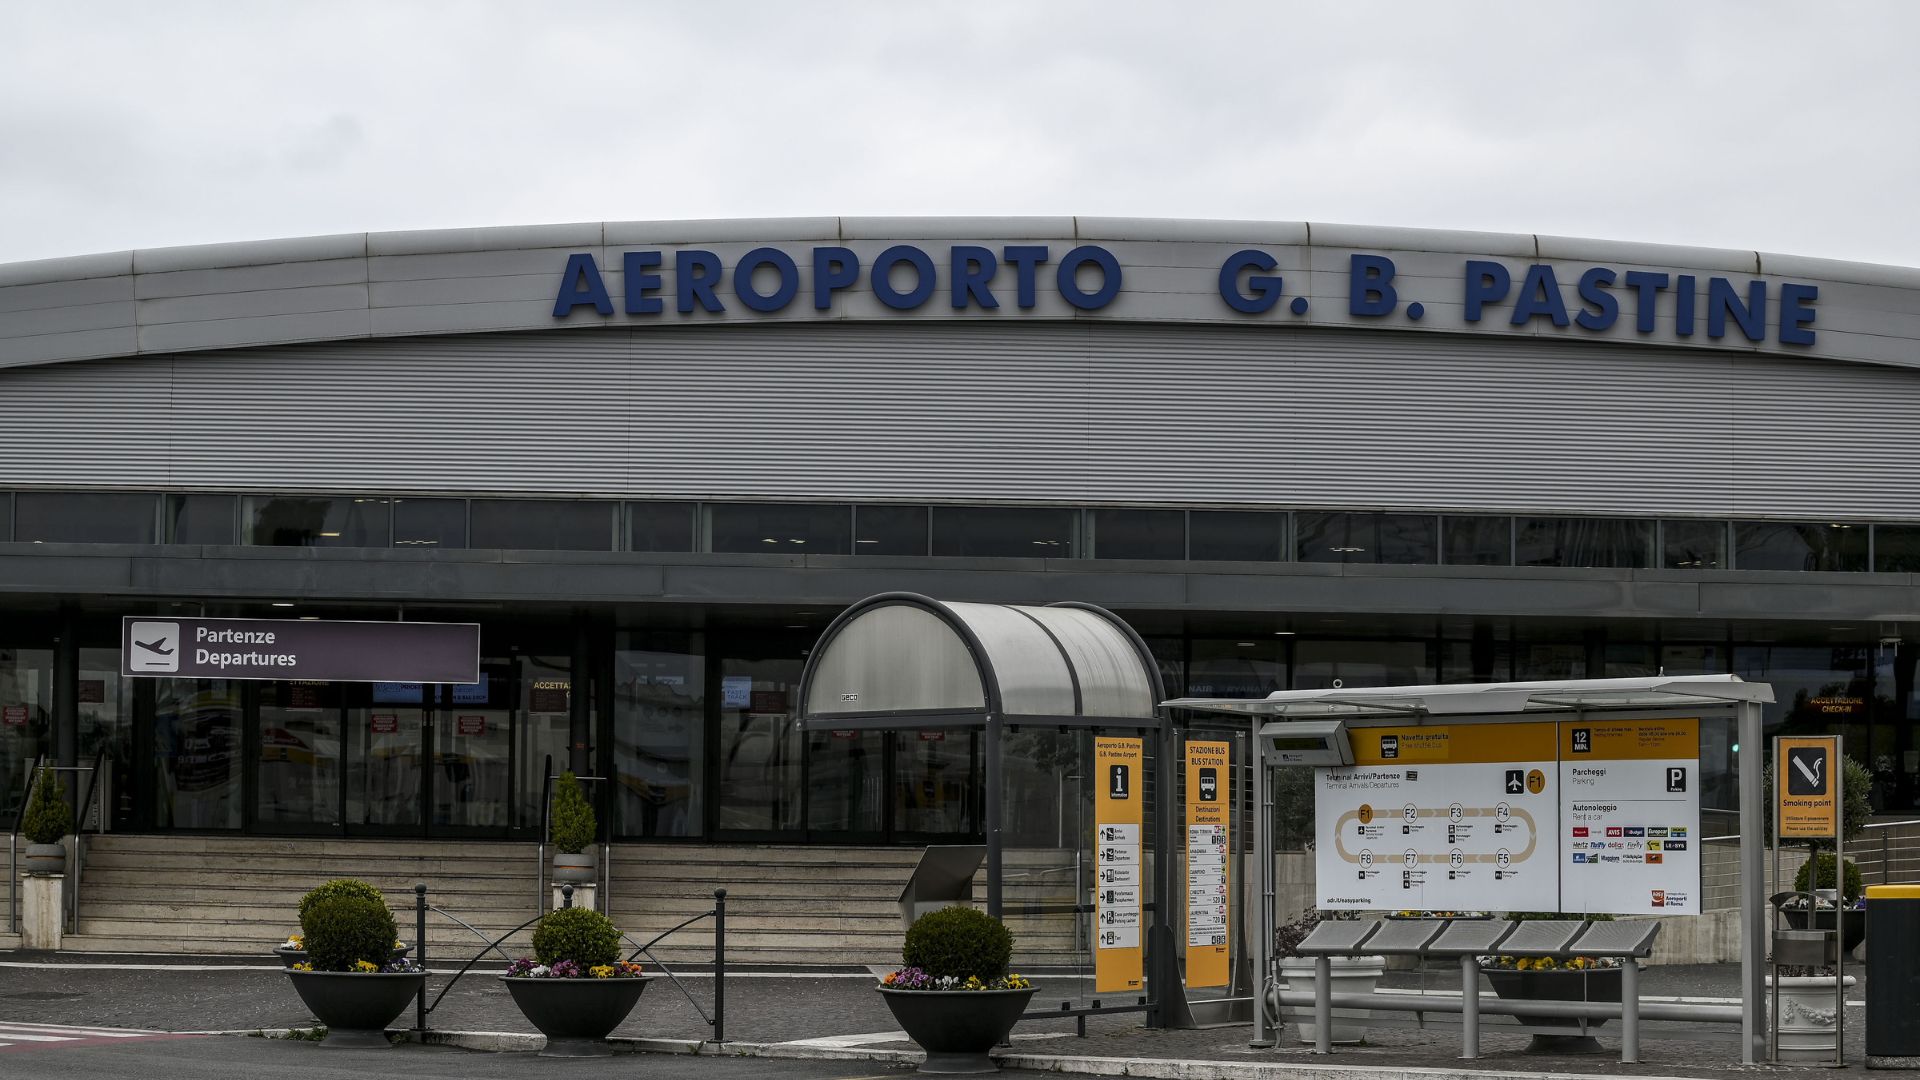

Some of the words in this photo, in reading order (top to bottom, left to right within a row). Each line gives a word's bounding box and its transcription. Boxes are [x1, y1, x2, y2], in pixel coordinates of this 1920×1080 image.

[552, 245, 1123, 317] AEROPORTO
[1219, 249, 1308, 315] G.
[1350, 253, 1424, 320] B.
[1464, 259, 1818, 346] PASTINE
[196, 627, 275, 644] Partenze
[196, 649, 296, 669] Departures
[1189, 685, 1213, 693] NAIR
[1810, 697, 1863, 705] ACCETTAZIONE
[1822, 705, 1852, 713] CHECK-IN
[1426, 734, 1448, 742] gratuita
[1575, 732, 1586, 743] 12
[1097, 742, 1117, 750] Aeroporto
[1575, 743, 1588, 751] MIN.
[1123, 751, 1137, 759] Airport
[1190, 747, 1215, 755] STAZIONE
[1203, 758, 1224, 766] STATION
[1353, 773, 1401, 781] Arrivi/Partenze
[1572, 768, 1607, 777] Parcheggi
[1530, 776, 1541, 788] F1
[1572, 778, 1595, 786] Parking
[1671, 769, 1682, 786] P
[1572, 804, 1618, 812] Autonoleggio
[1783, 799, 1813, 809] Smoking
[1814, 800, 1832, 809] point
[1360, 810, 1370, 818] F1
[1405, 808, 1416, 818] F2
[1451, 808, 1461, 818] F3
[1497, 807, 1508, 817] F4
[1361, 854, 1371, 864] F8
[1405, 854, 1416, 864] F7
[1451, 854, 1462, 863] F6
[1498, 854, 1509, 863] F5
